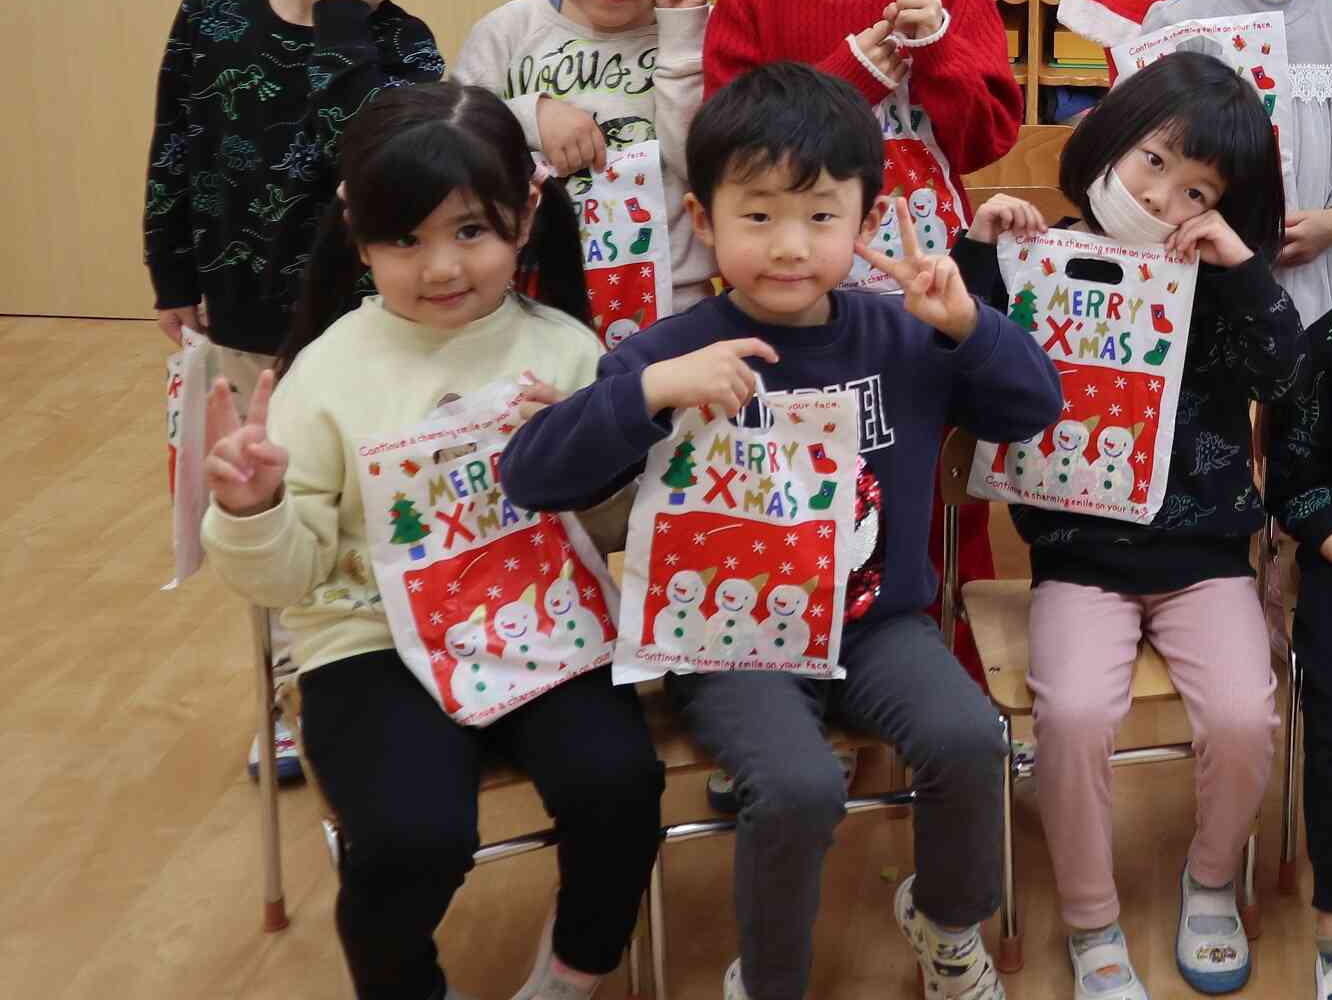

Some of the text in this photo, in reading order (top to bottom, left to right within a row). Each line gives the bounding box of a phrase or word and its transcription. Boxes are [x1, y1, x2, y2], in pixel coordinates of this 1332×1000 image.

[1047, 284, 1145, 325] MERRY
[706, 433, 800, 474] MERRY
[635, 649, 681, 665] Continue
